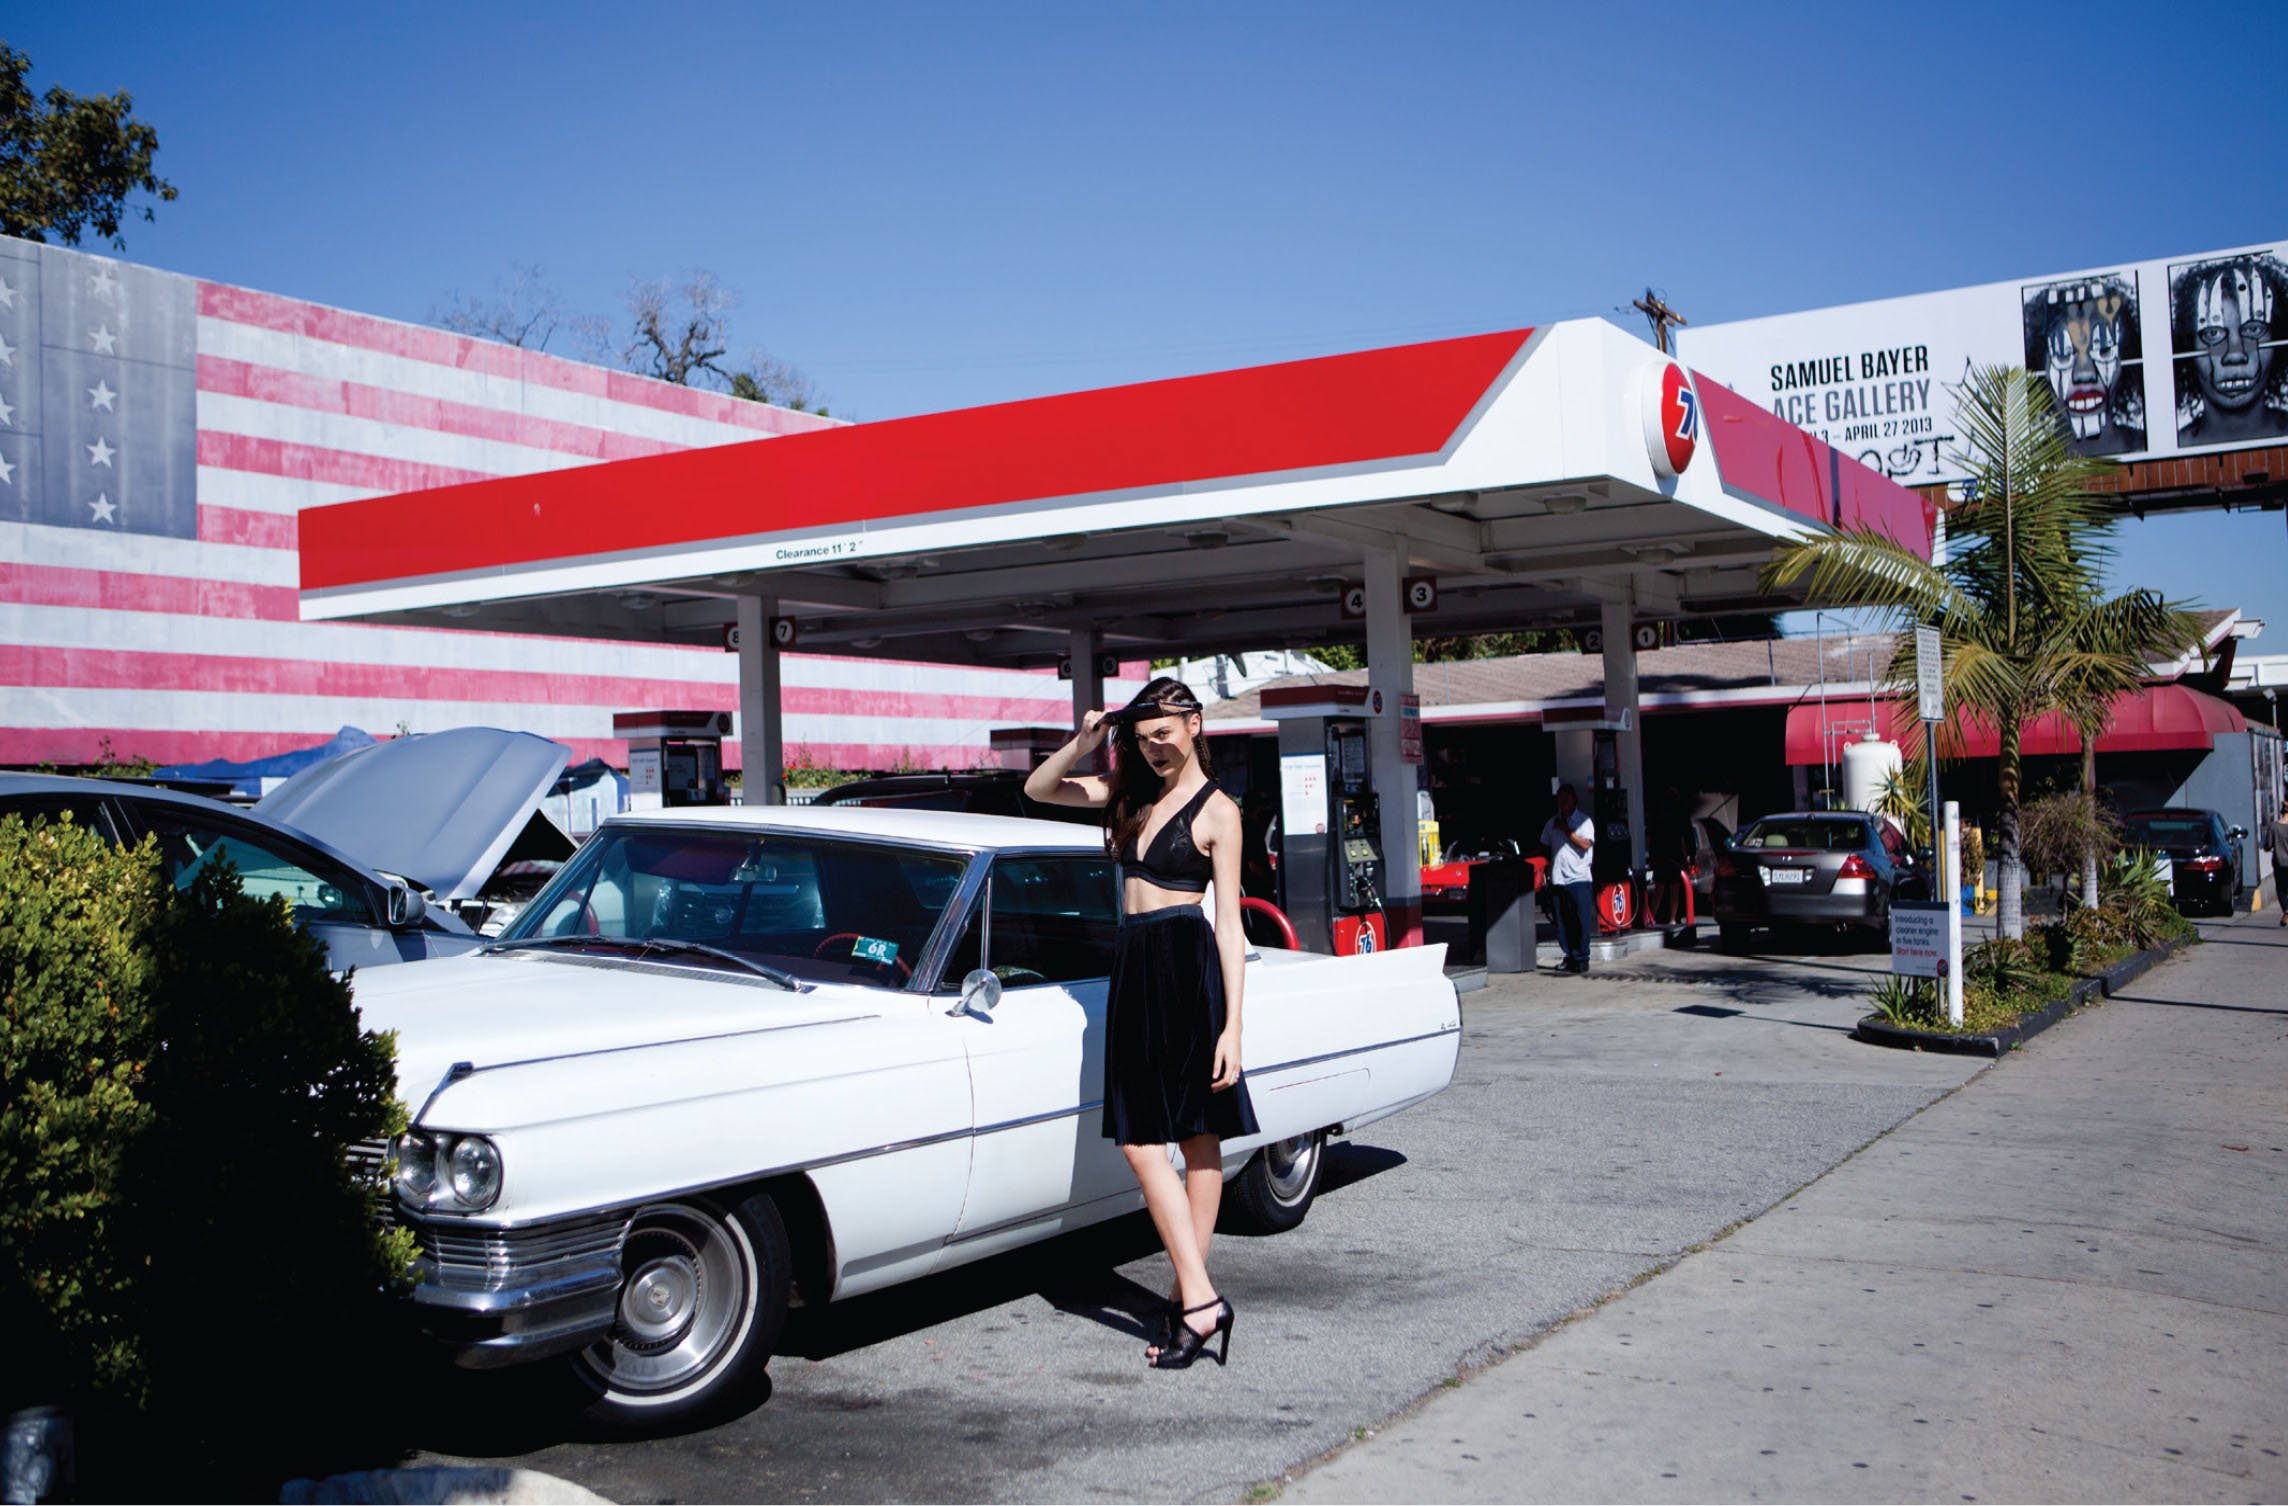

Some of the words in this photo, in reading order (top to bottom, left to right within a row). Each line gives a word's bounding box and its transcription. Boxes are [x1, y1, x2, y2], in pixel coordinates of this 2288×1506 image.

[1771, 355, 1855, 391] SAMUEL
[1861, 345, 1929, 379] BAYER
[1825, 378, 1931, 422] GALLERY
[1845, 423, 1880, 442] APRIL
[1884, 420, 1898, 436] 27
[1902, 416, 1933, 435] 2013
[776, 546, 830, 560] Clearance
[1351, 593, 1363, 608] 4
[1415, 587, 1427, 602] 3
[779, 624, 787, 638] 7
[1641, 631, 1648, 643] 1
[1895, 915, 1928, 926] Introducing
[1929, 917, 1934, 925] a
[1918, 927, 1939, 937] engine
[868, 942, 887, 957] 6R
[1359, 930, 1373, 954] 76
[1896, 946, 1909, 956] Start
